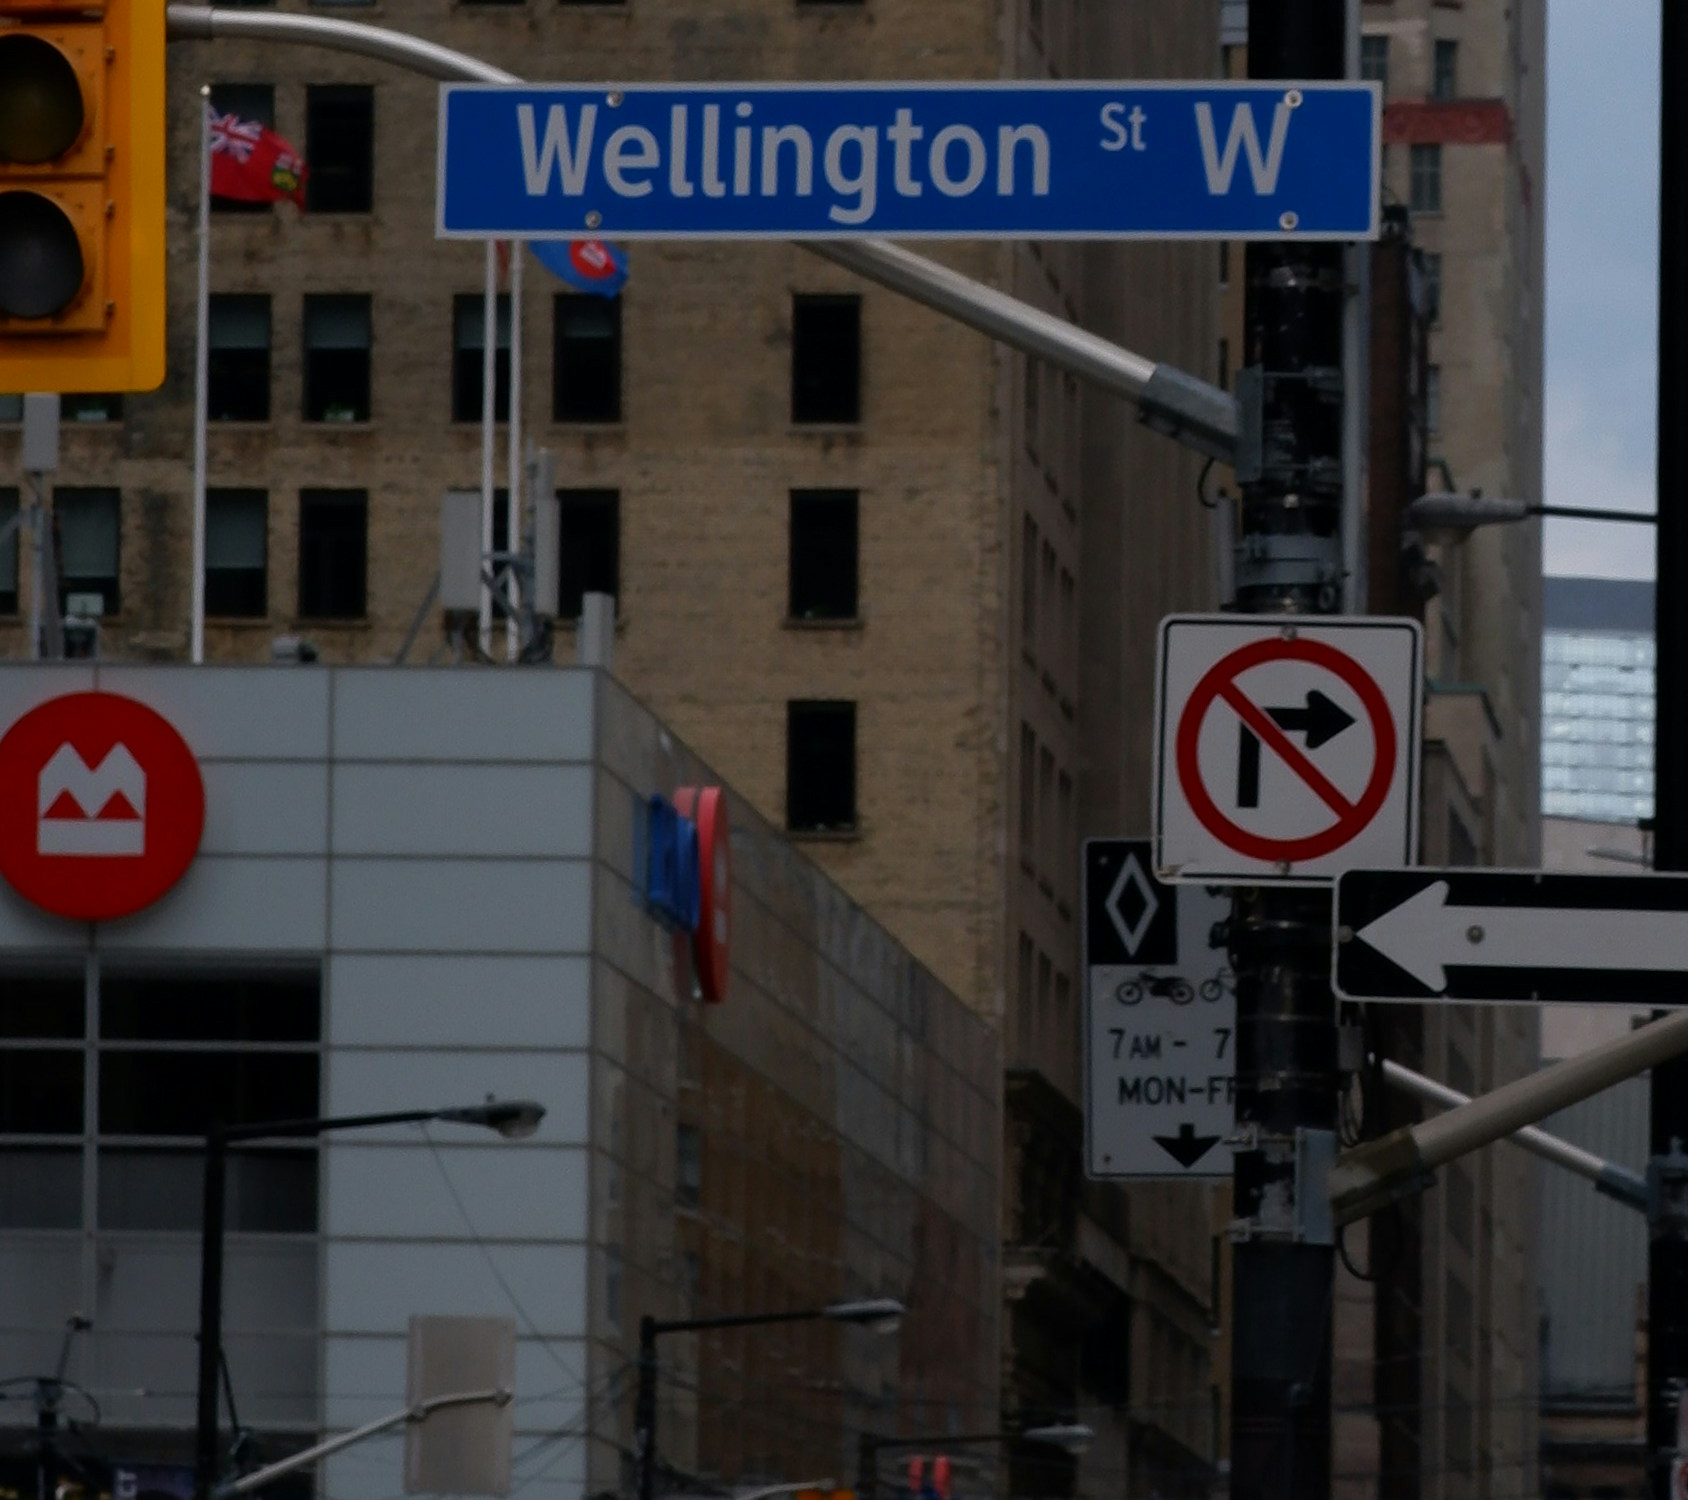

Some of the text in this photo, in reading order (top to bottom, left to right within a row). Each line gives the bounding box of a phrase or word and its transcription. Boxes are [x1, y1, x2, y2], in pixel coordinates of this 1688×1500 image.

[517, 102, 1293, 225] Wellington St W
